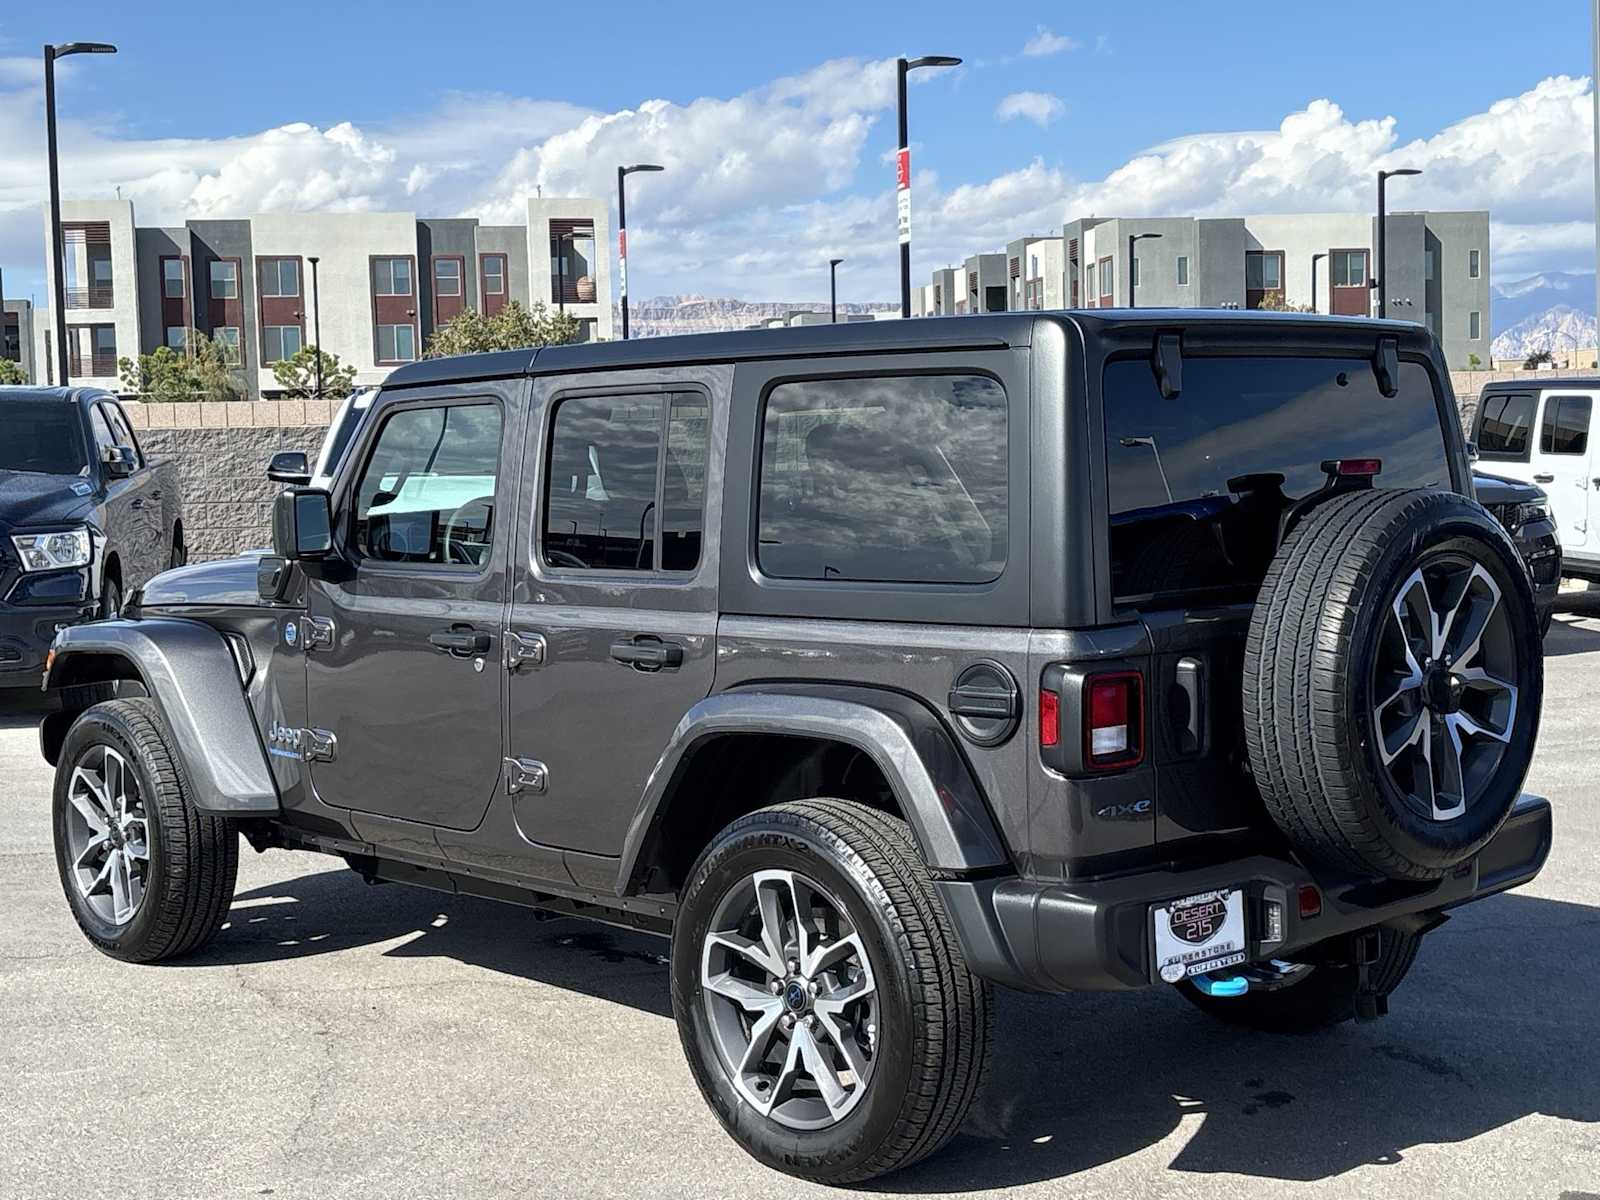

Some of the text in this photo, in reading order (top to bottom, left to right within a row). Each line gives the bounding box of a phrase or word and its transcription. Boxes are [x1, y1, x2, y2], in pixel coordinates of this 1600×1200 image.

[269, 720, 301, 749] Jeep
[1174, 902, 1221, 923] DESERT
[1186, 919, 1213, 940] 215
